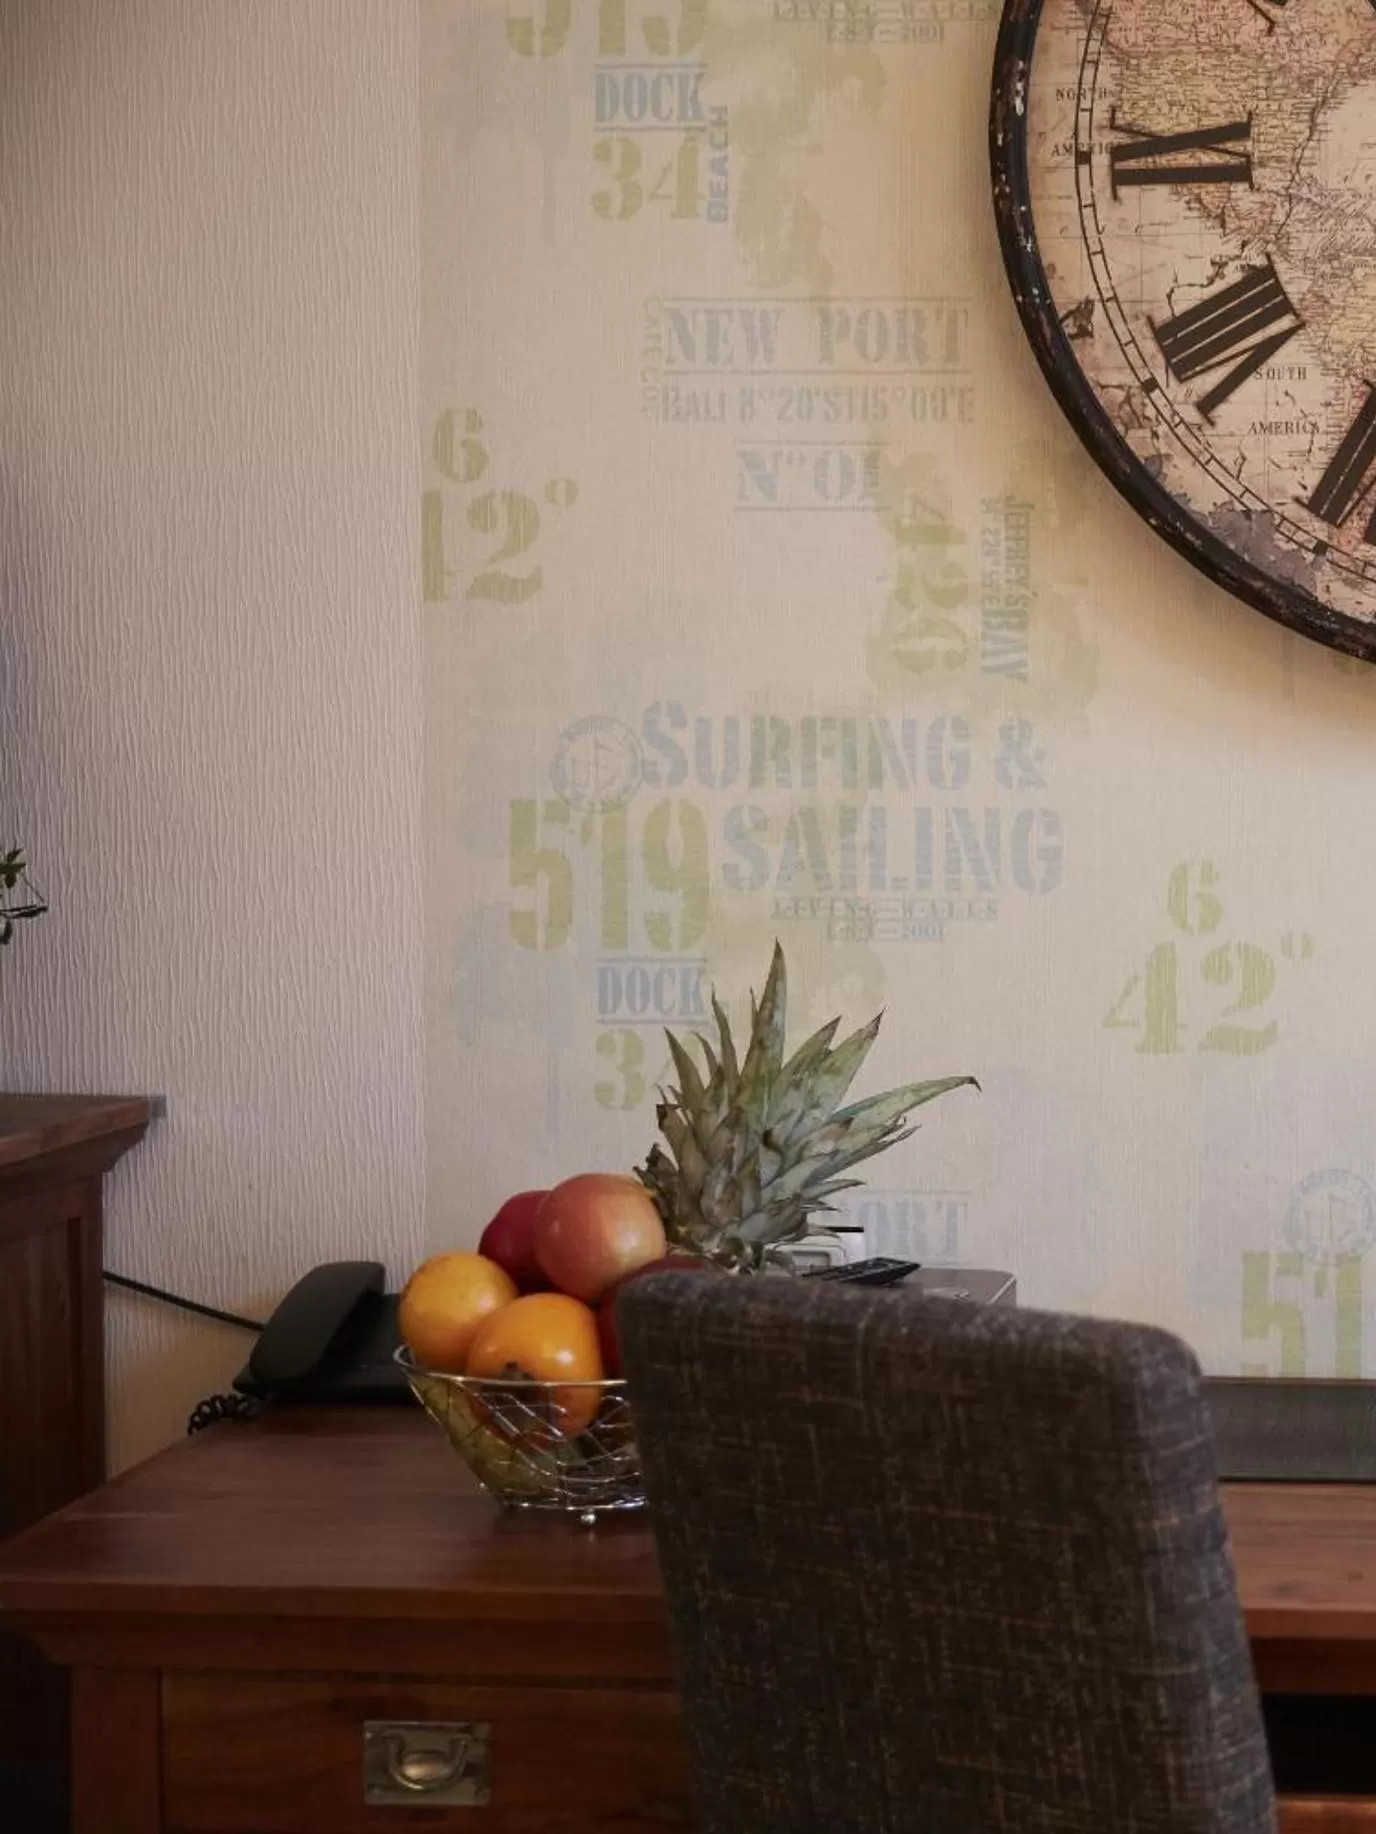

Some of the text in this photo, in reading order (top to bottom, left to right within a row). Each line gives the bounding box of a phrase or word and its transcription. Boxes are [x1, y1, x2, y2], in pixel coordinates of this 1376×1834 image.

[595, 72, 703, 122] DOCK
[591, 135, 700, 221] 34
[706, 105, 728, 223] BEACH
[664, 306, 972, 365] NEW PORT
[432, 408, 489, 484] 6
[641, 702, 972, 790] SURFING
[994, 716, 1048, 789] &
[508, 797, 710, 951] 519
[721, 804, 1063, 894] SAILING
[1167, 861, 1223, 935] 6
[597, 966, 704, 1018] DOCK
